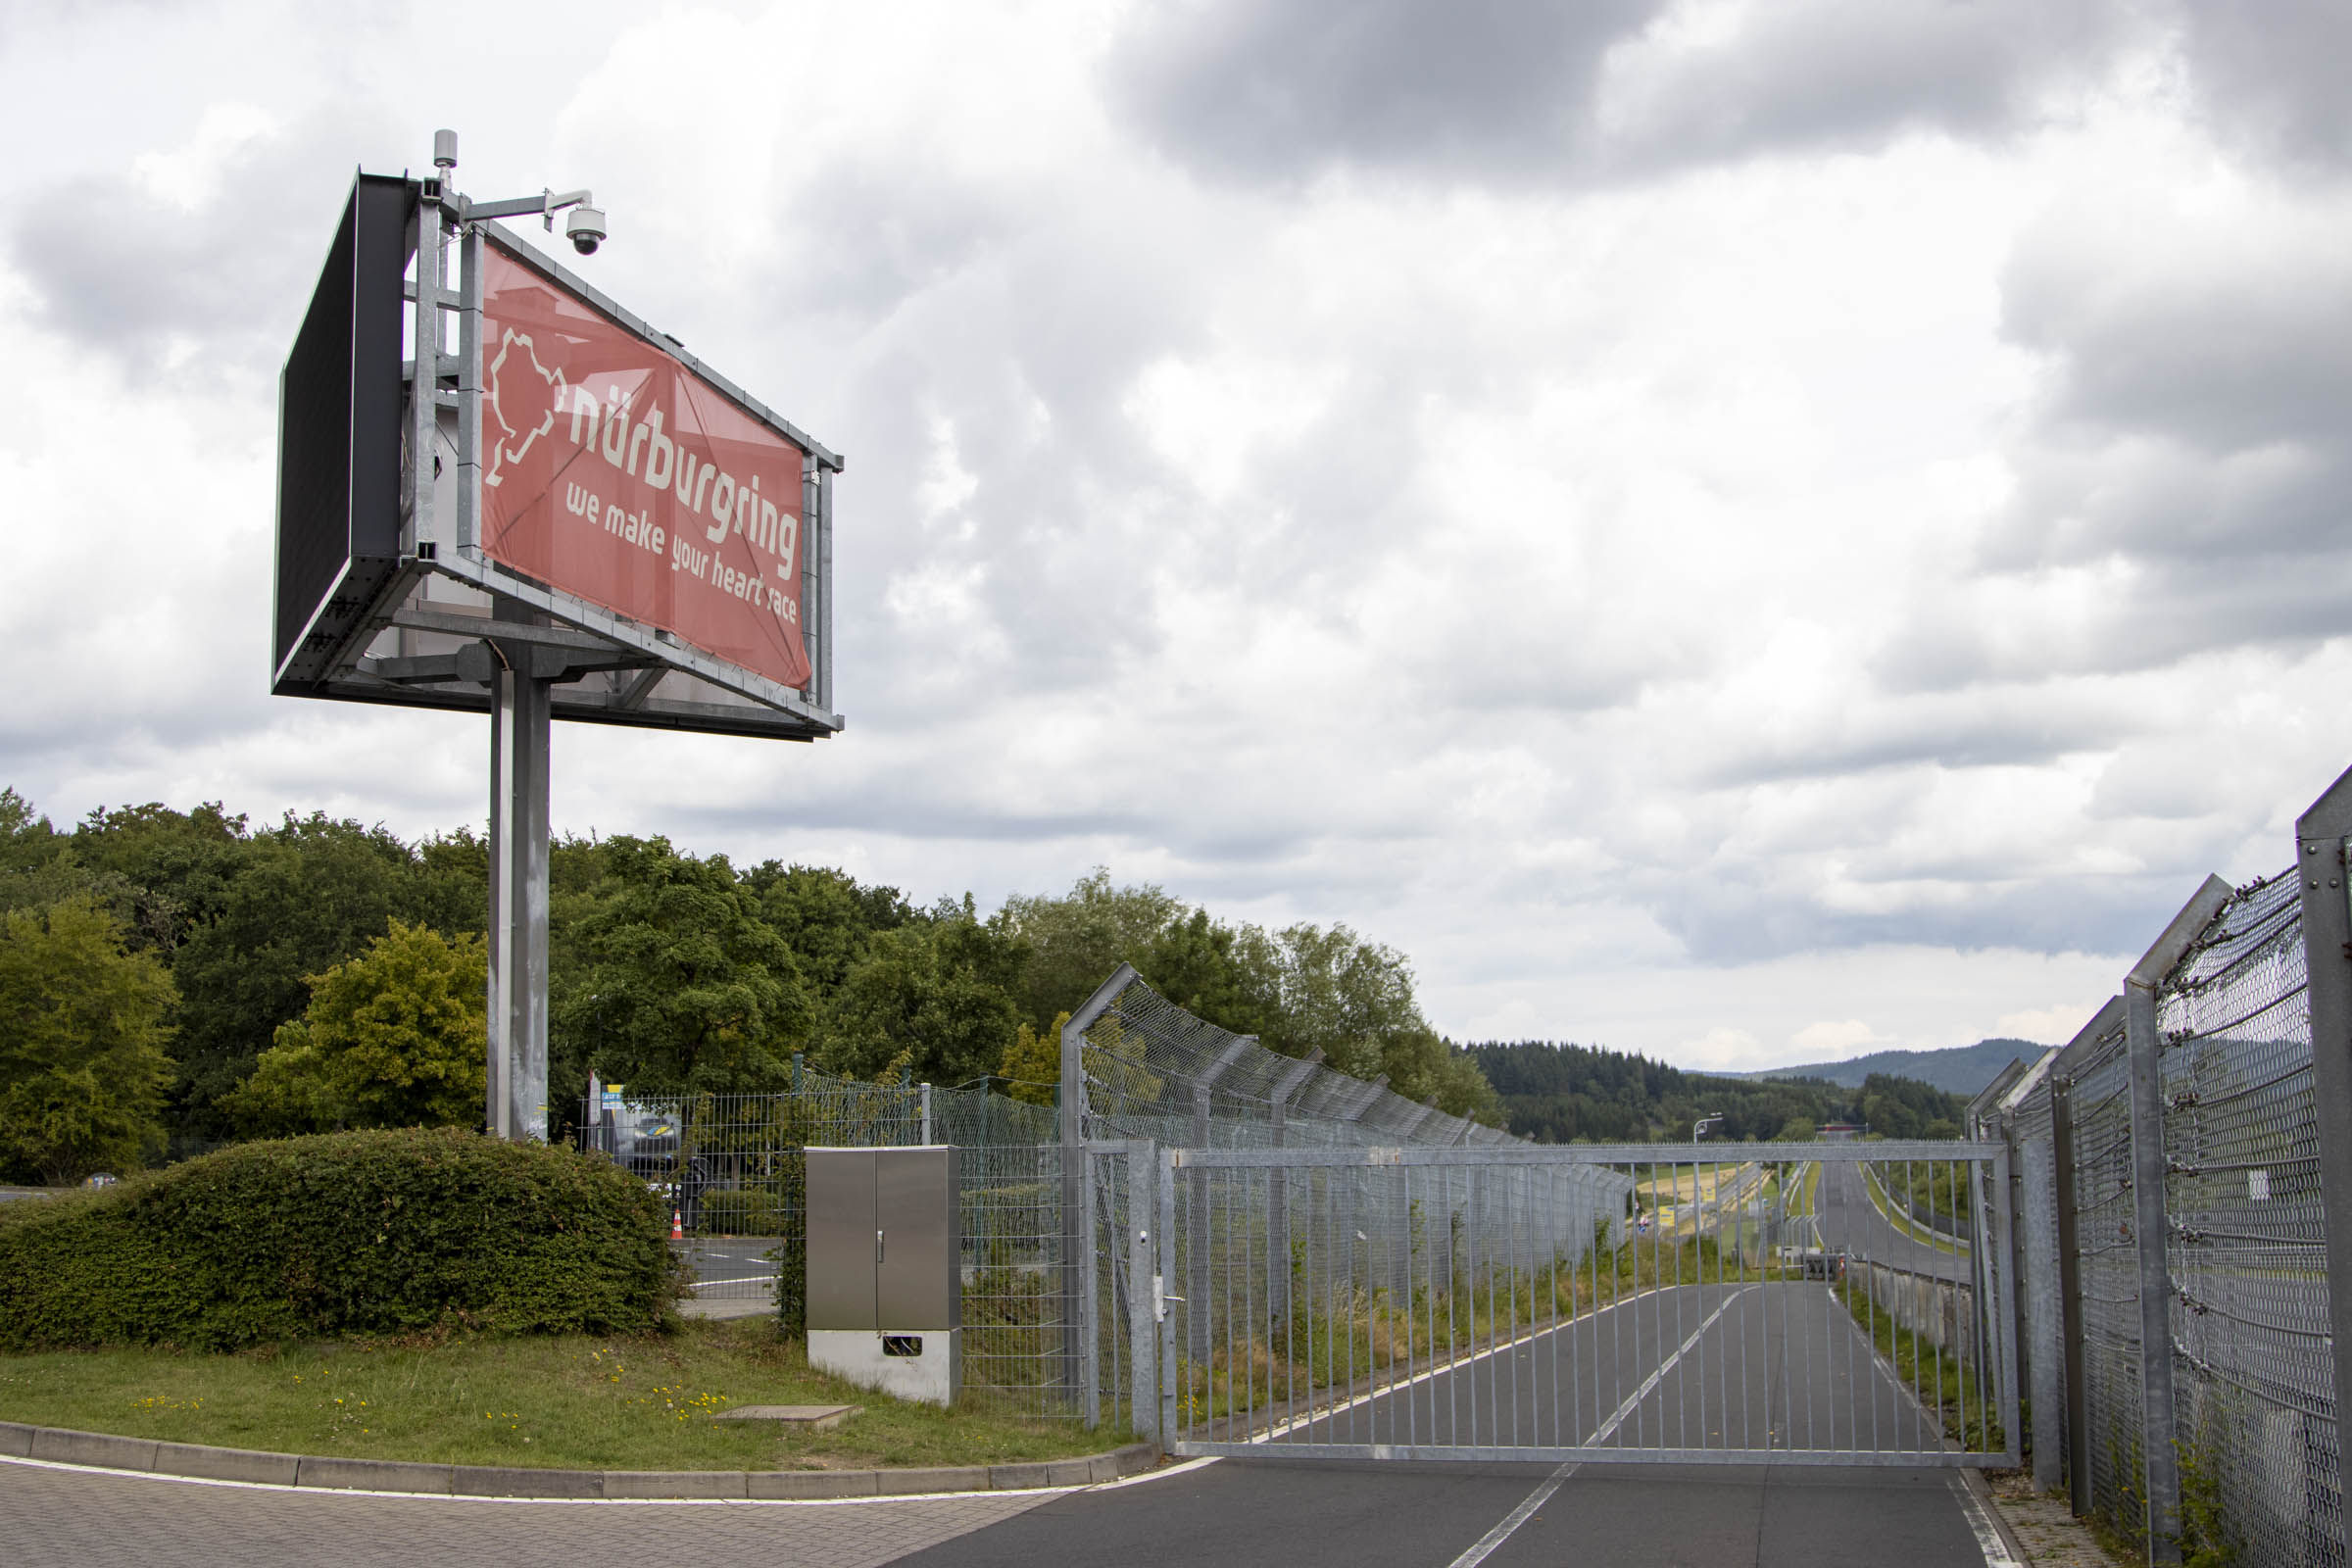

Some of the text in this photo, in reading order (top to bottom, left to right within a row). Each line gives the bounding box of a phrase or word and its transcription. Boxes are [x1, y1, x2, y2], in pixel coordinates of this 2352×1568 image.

[565, 481, 797, 624] we make your heart race
[569, 384, 798, 581] nürburgring
